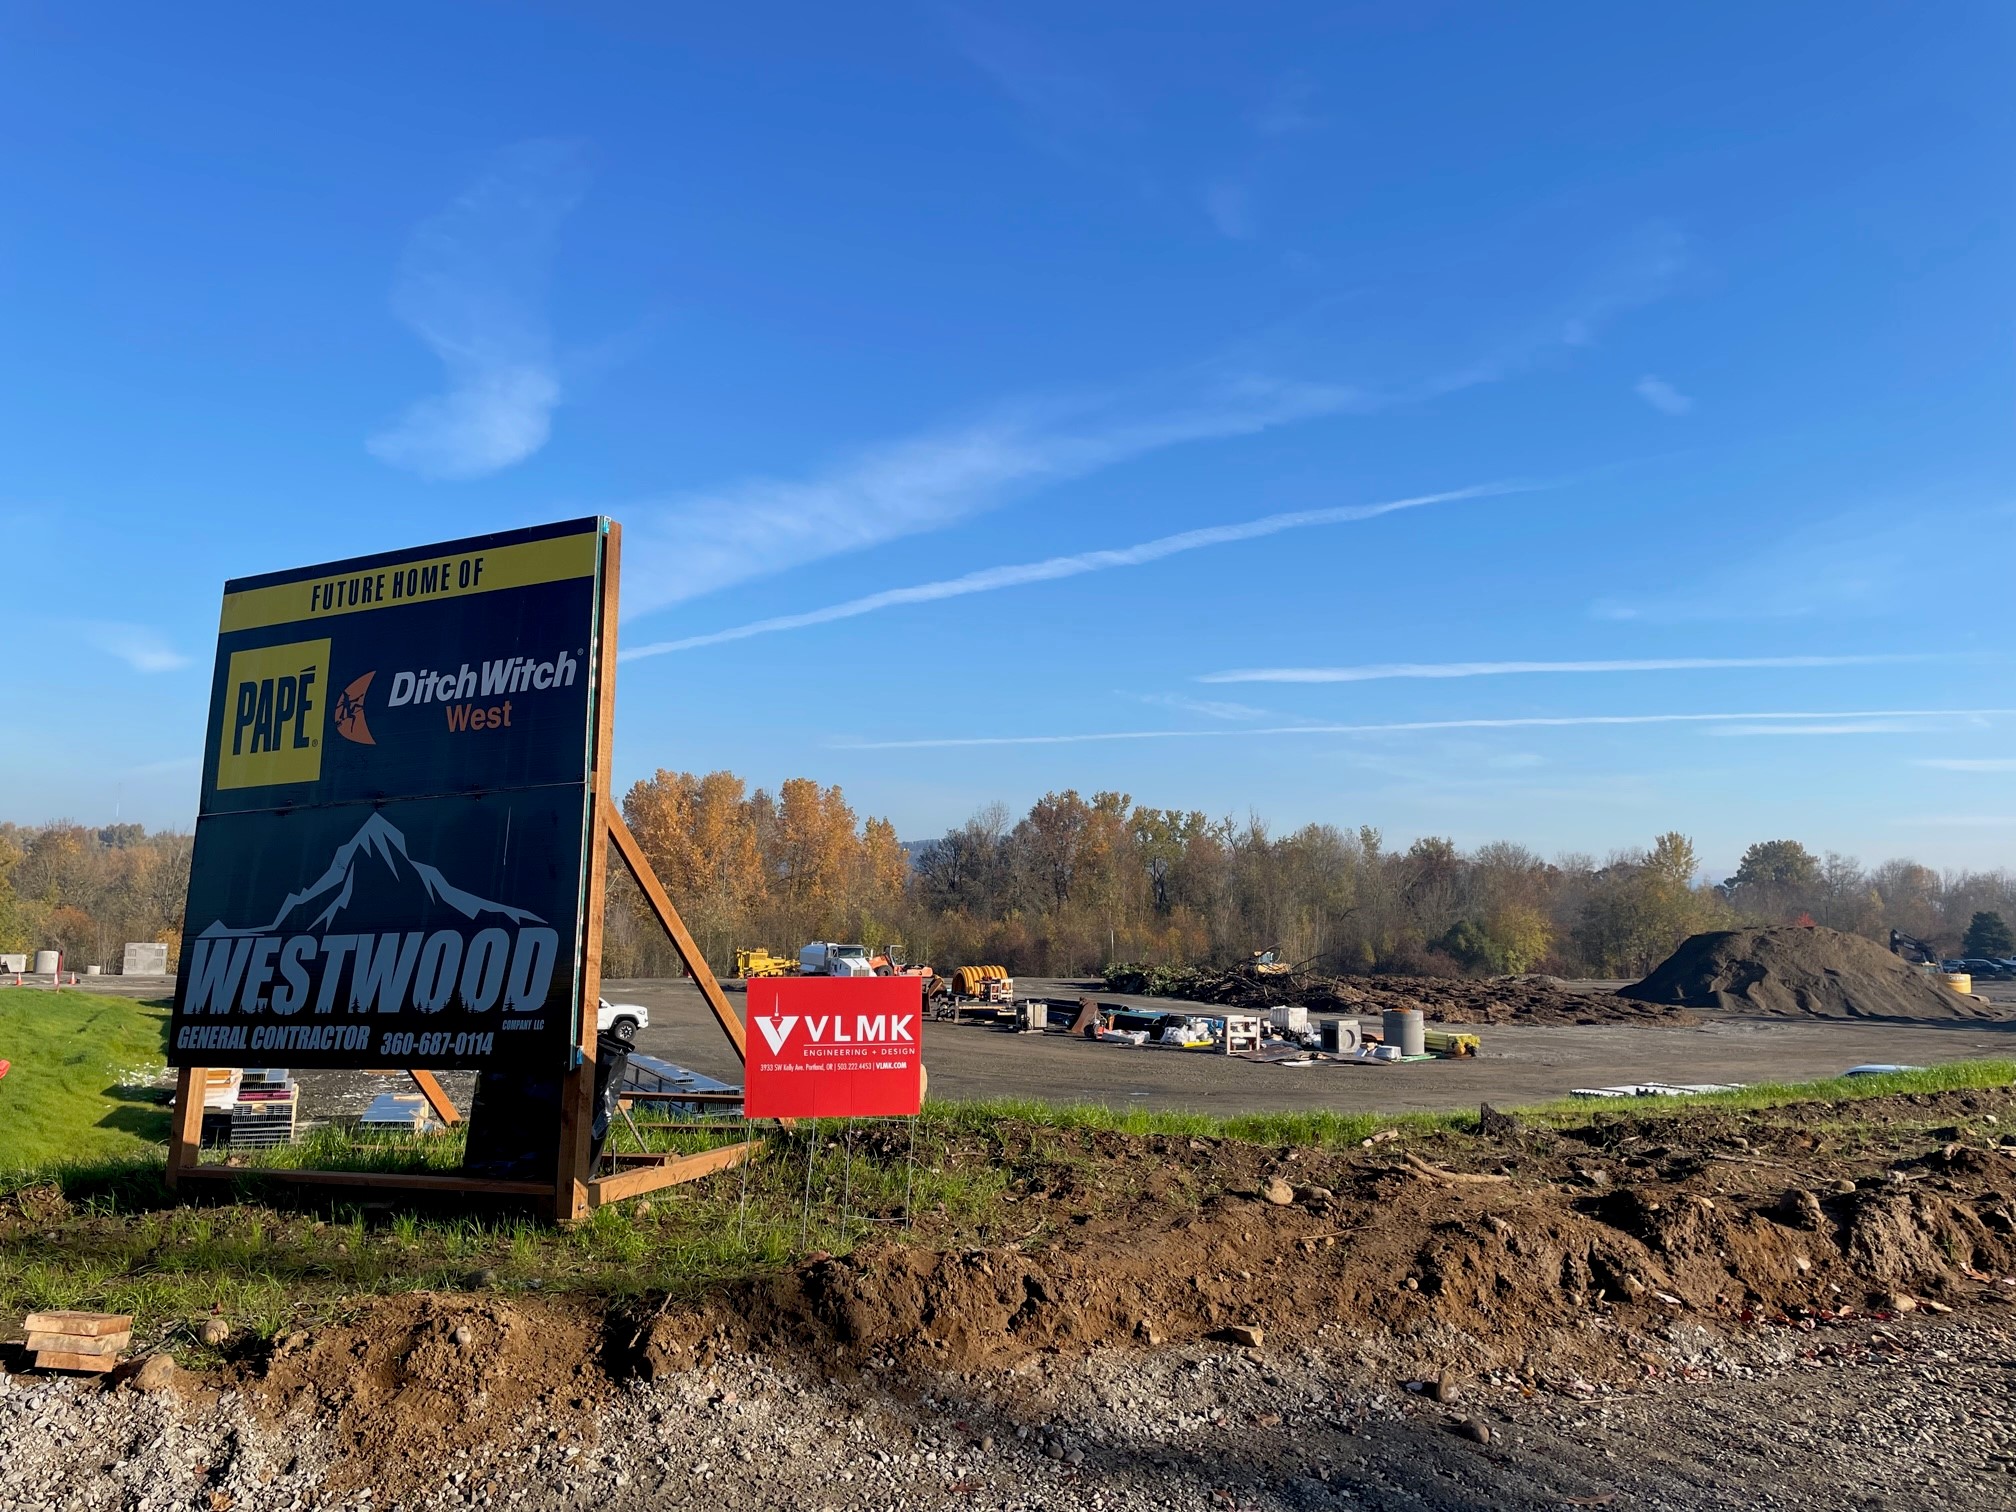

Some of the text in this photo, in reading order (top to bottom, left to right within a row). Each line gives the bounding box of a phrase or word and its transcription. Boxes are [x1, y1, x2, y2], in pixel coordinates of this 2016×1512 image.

[311, 557, 484, 612] FUTURE HOME OF
[446, 701, 512, 733] West
[183, 927, 559, 1016] WESTWOOD
[502, 1019, 545, 1030] COMPANY LLC
[804, 1014, 914, 1042] VLMK
[177, 1025, 495, 1056] GENERAL CONTRACTOR 360-687-0114
[803, 1049, 868, 1057] ENGINEERING
[881, 1047, 916, 1056] DESIGN
[774, 1063, 782, 1072] SW
[826, 1062, 833, 1071] OR
[876, 1061, 908, 1070] VLMK.COM
